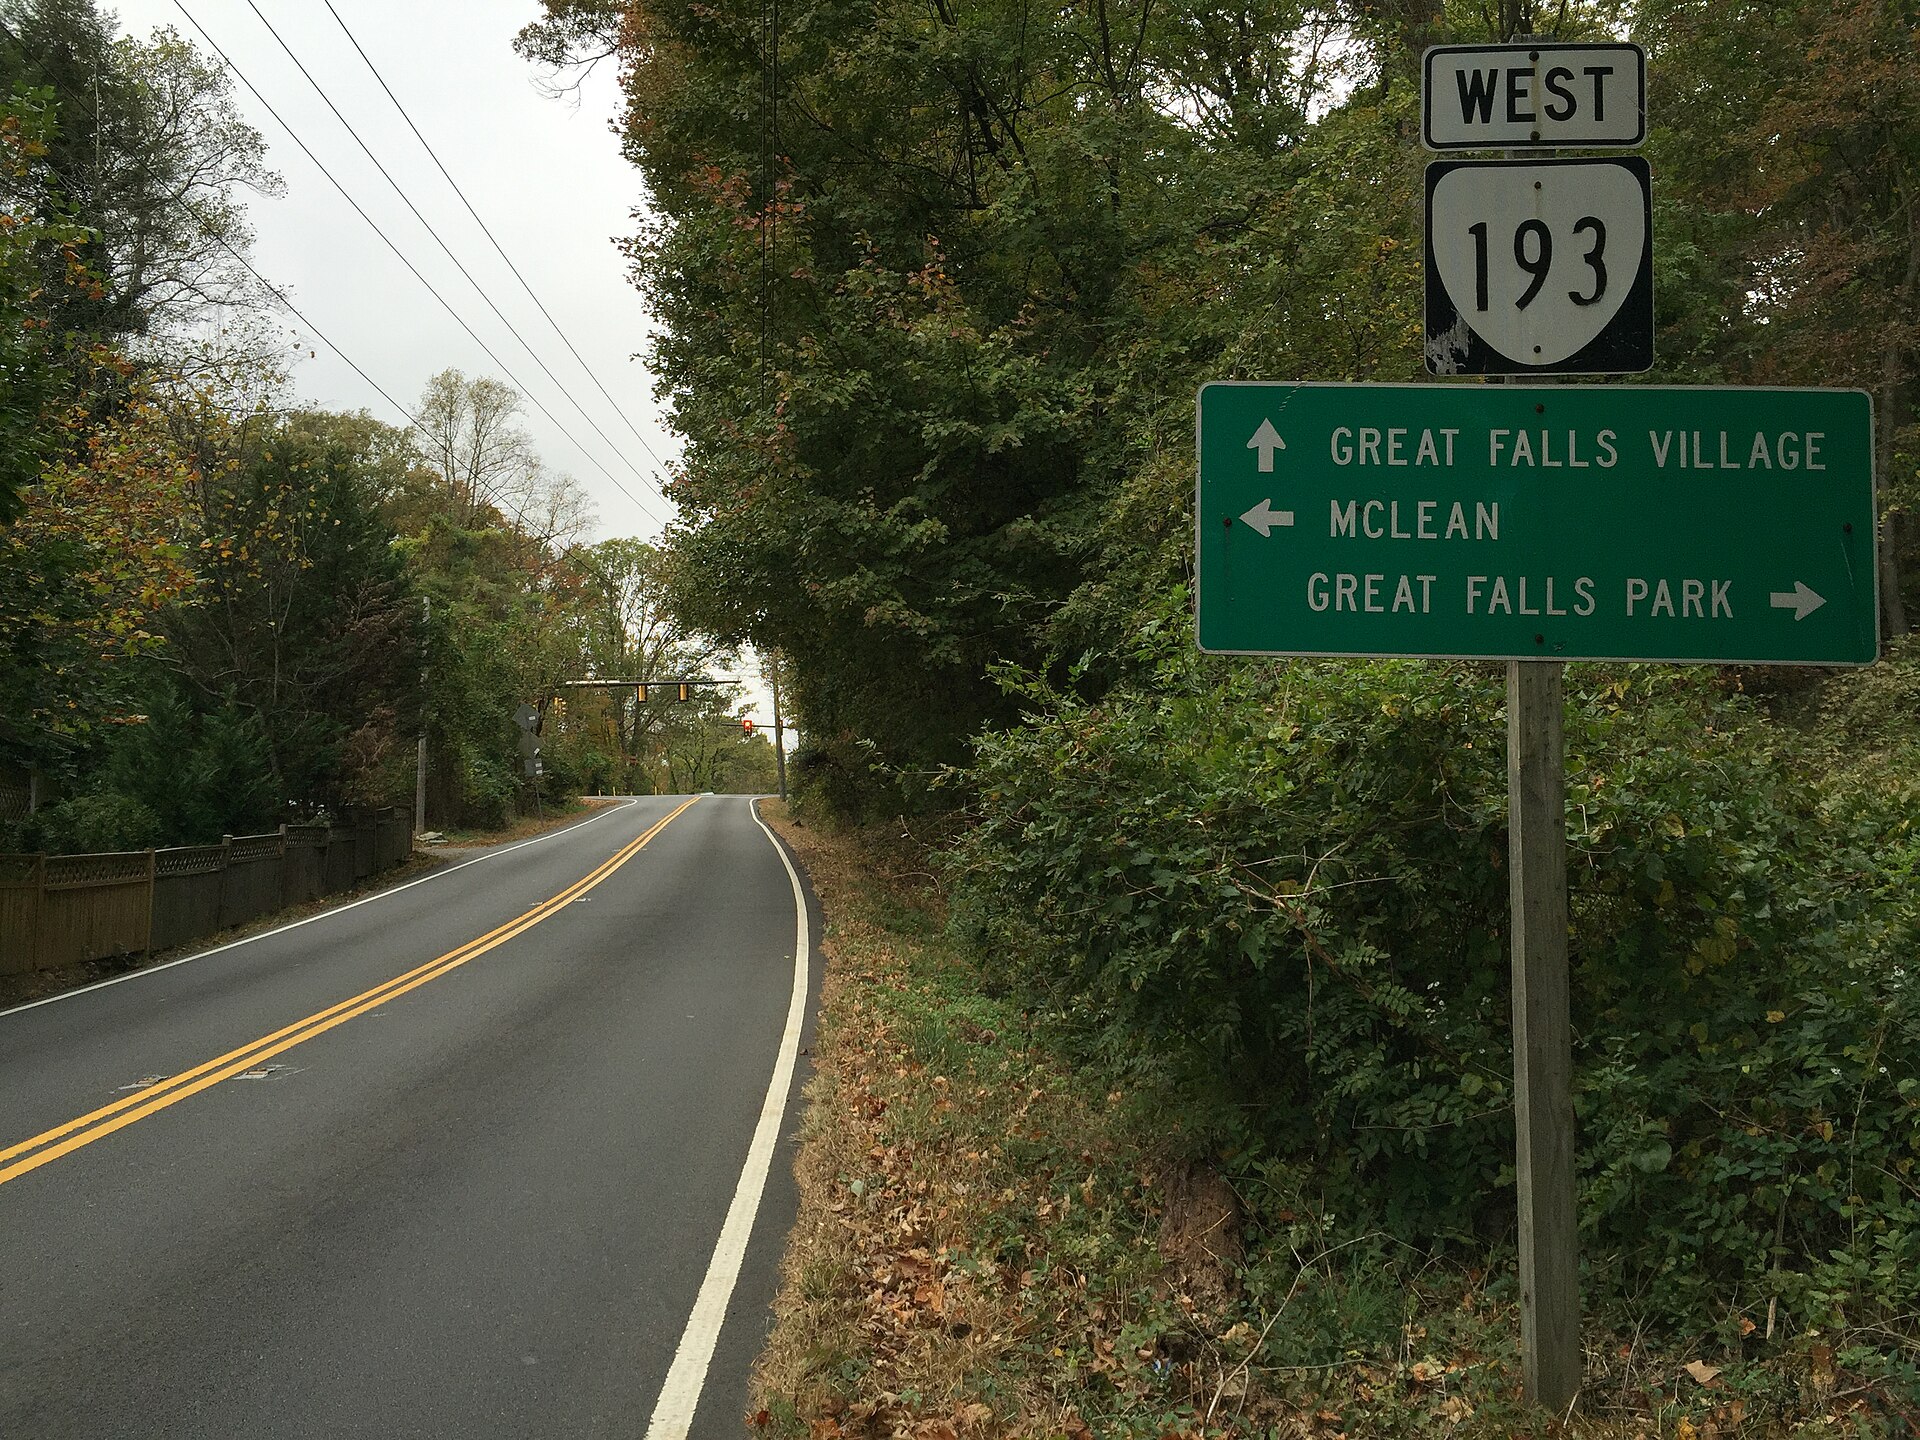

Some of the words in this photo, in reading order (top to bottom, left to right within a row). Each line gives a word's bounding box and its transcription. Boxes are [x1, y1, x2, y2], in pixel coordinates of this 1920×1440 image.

[1455, 66, 1614, 125] WEST
[1467, 215, 1608, 313] 193
[1330, 426, 1460, 467] GREAT
[1490, 429, 1618, 468] FALLS
[1650, 430, 1827, 472] VILLAGE
[1330, 499, 1500, 541] MCLEAN
[1307, 572, 1437, 613] GREAT
[1467, 576, 1596, 616] FALLS
[1626, 578, 1735, 619] PARK
